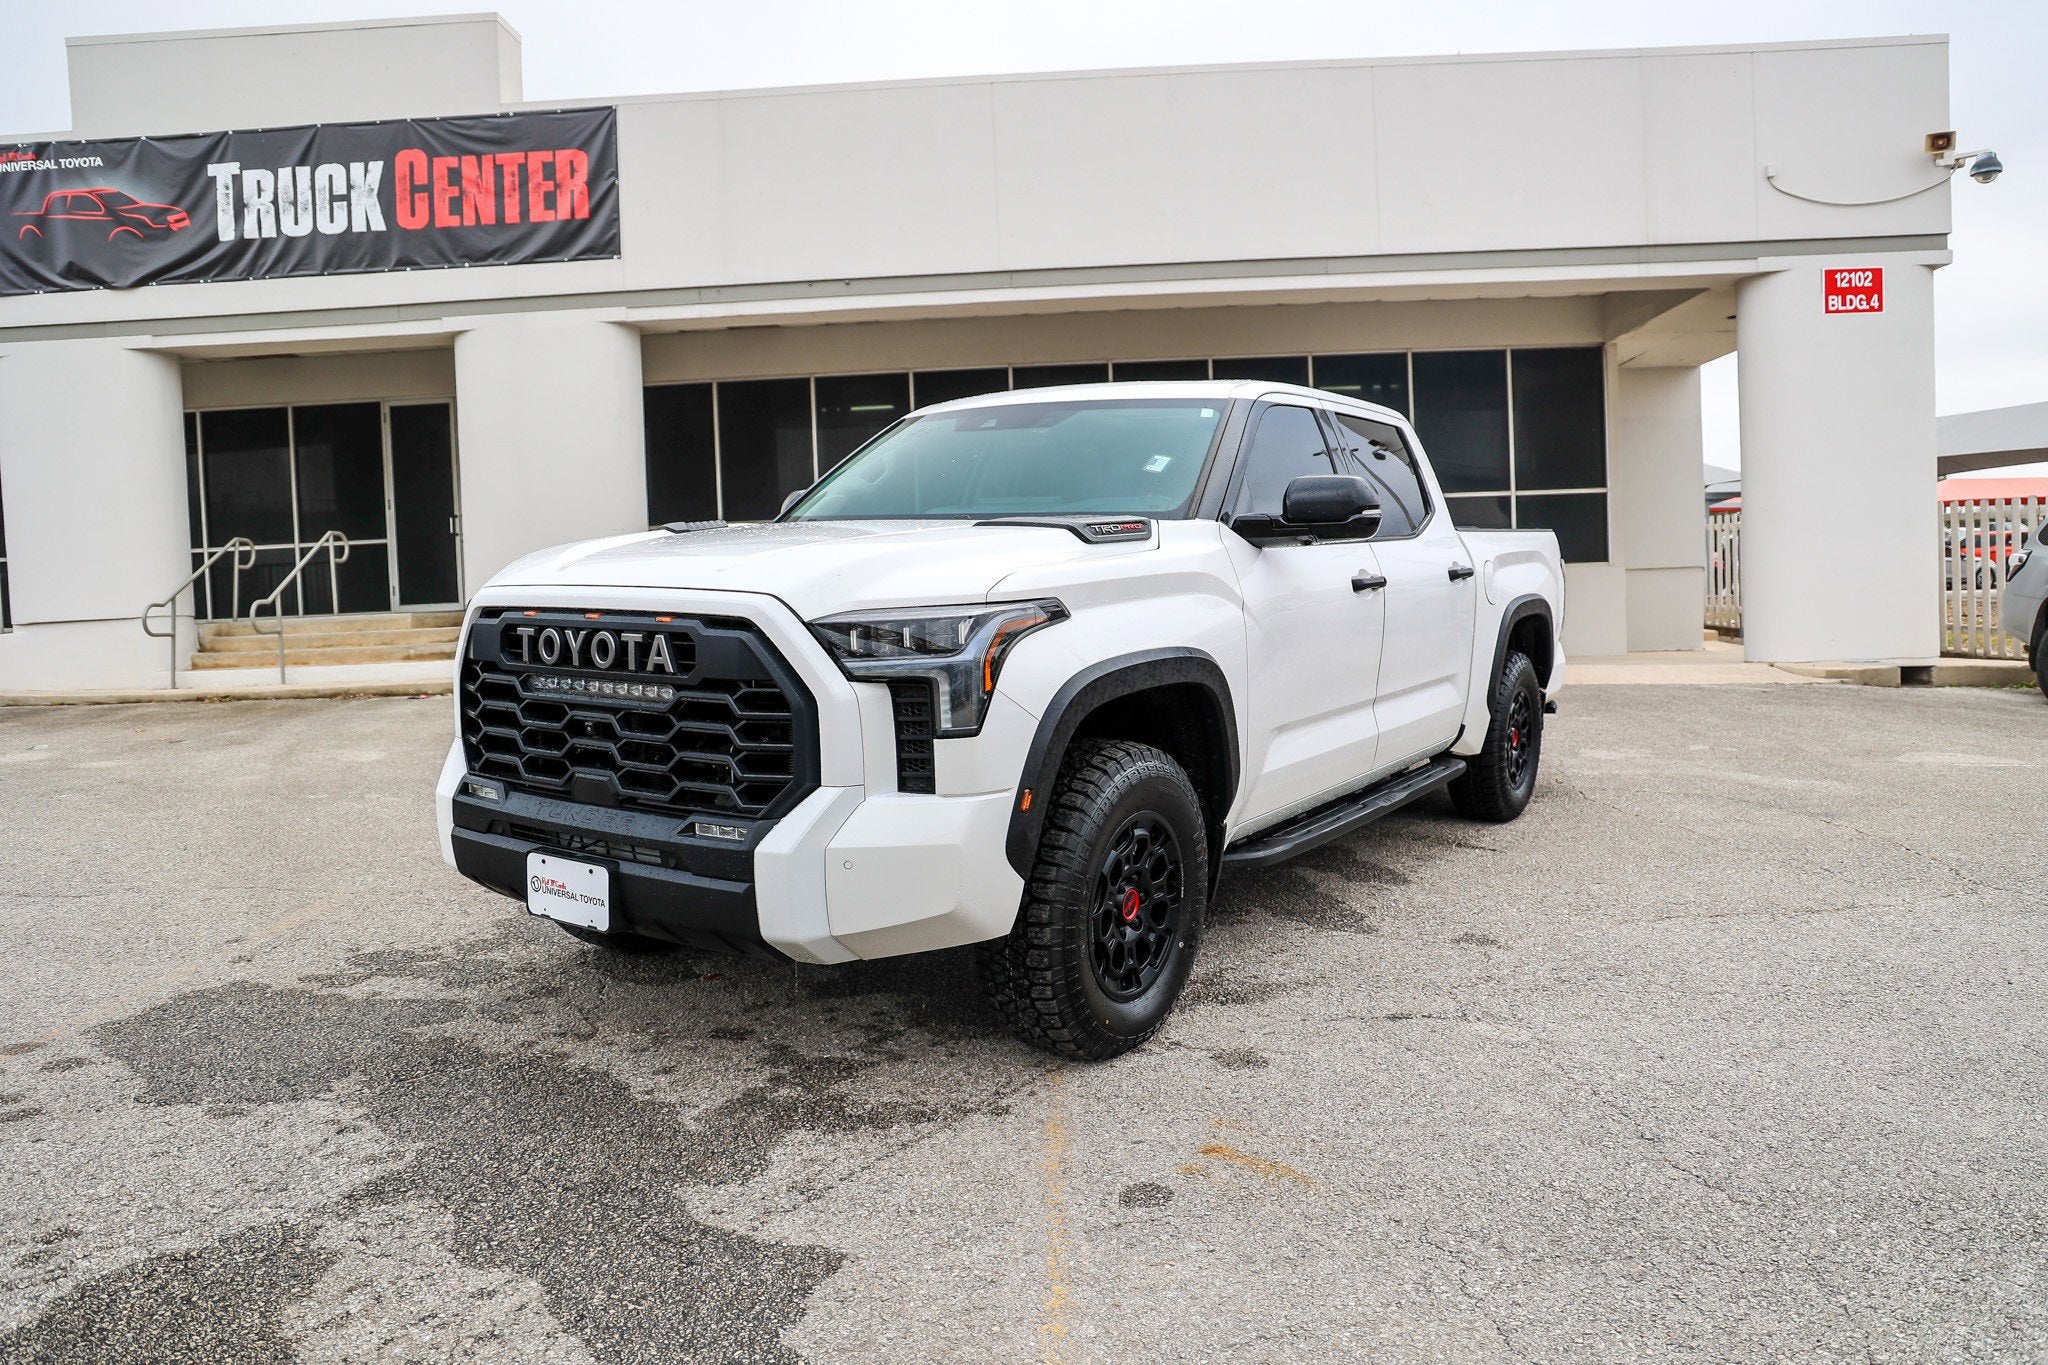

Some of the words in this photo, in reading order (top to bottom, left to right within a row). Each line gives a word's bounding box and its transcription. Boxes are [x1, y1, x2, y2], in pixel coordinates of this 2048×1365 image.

[59, 157, 104, 169] TOYOTA
[207, 160, 387, 242] TRUCK
[394, 148, 590, 230] CENTER
[1835, 271, 1873, 287] 12102
[516, 627, 676, 673] TOYOTA
[541, 886, 578, 902] UNIVERSAL
[579, 894, 605, 908] TOYOTA
